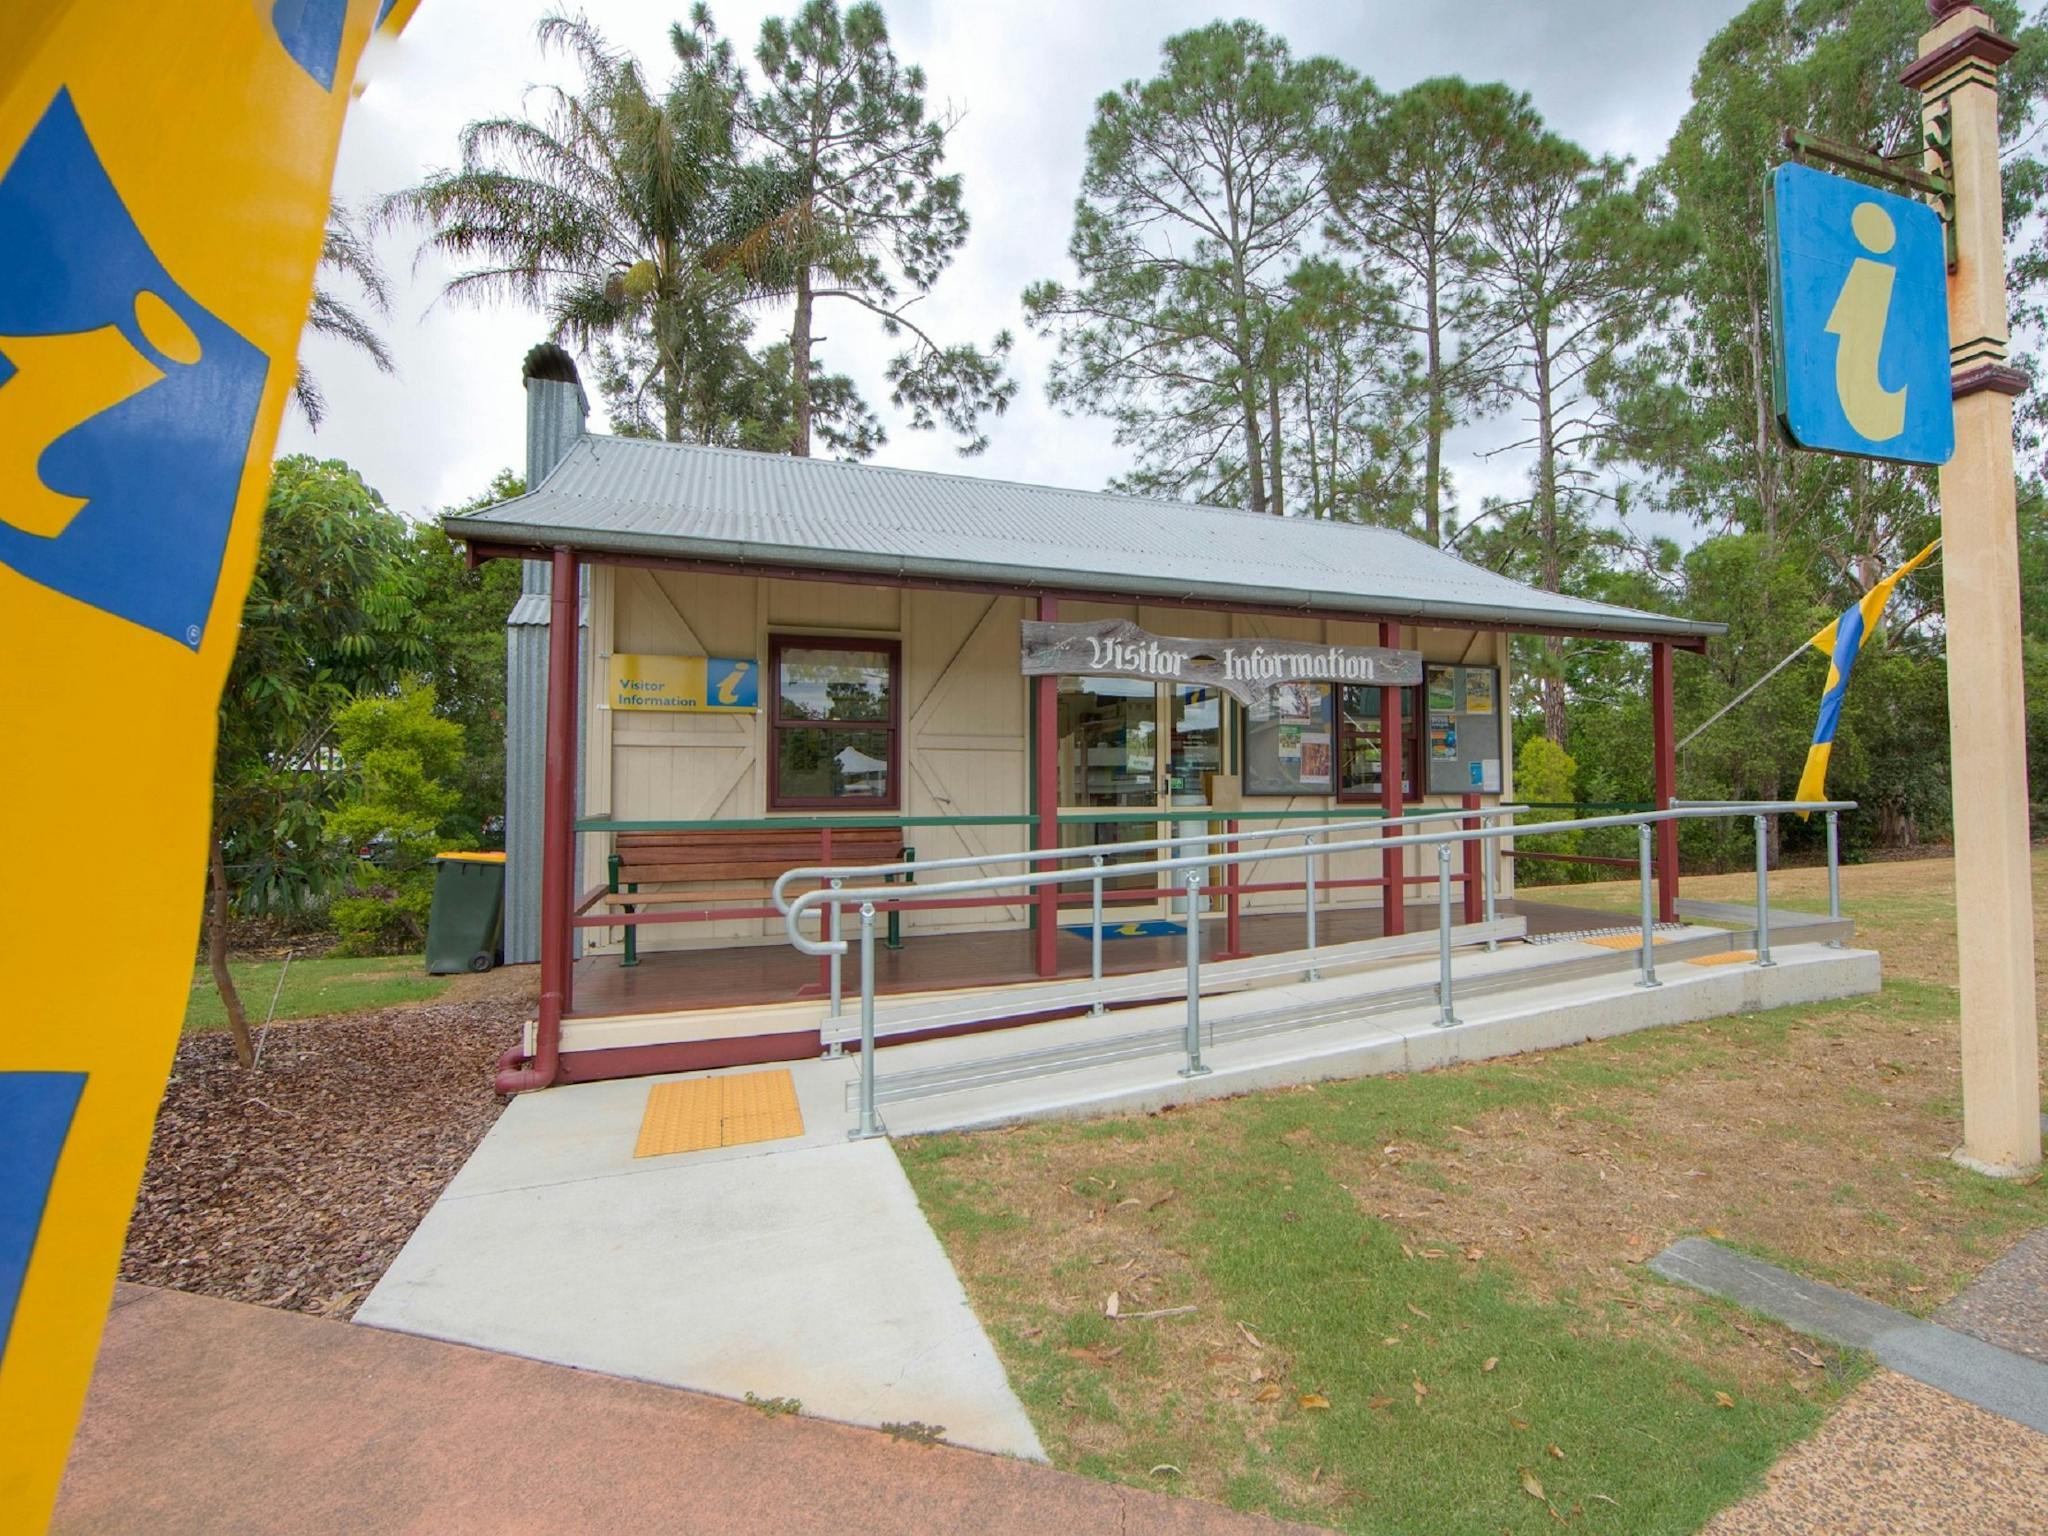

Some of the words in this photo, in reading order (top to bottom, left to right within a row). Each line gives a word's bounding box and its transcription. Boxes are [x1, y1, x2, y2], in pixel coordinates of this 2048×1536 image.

[1088, 636, 1188, 676] Visitor
[1223, 648, 1375, 681] Information
[620, 679, 665, 691] Visitor
[618, 694, 697, 706] Information
